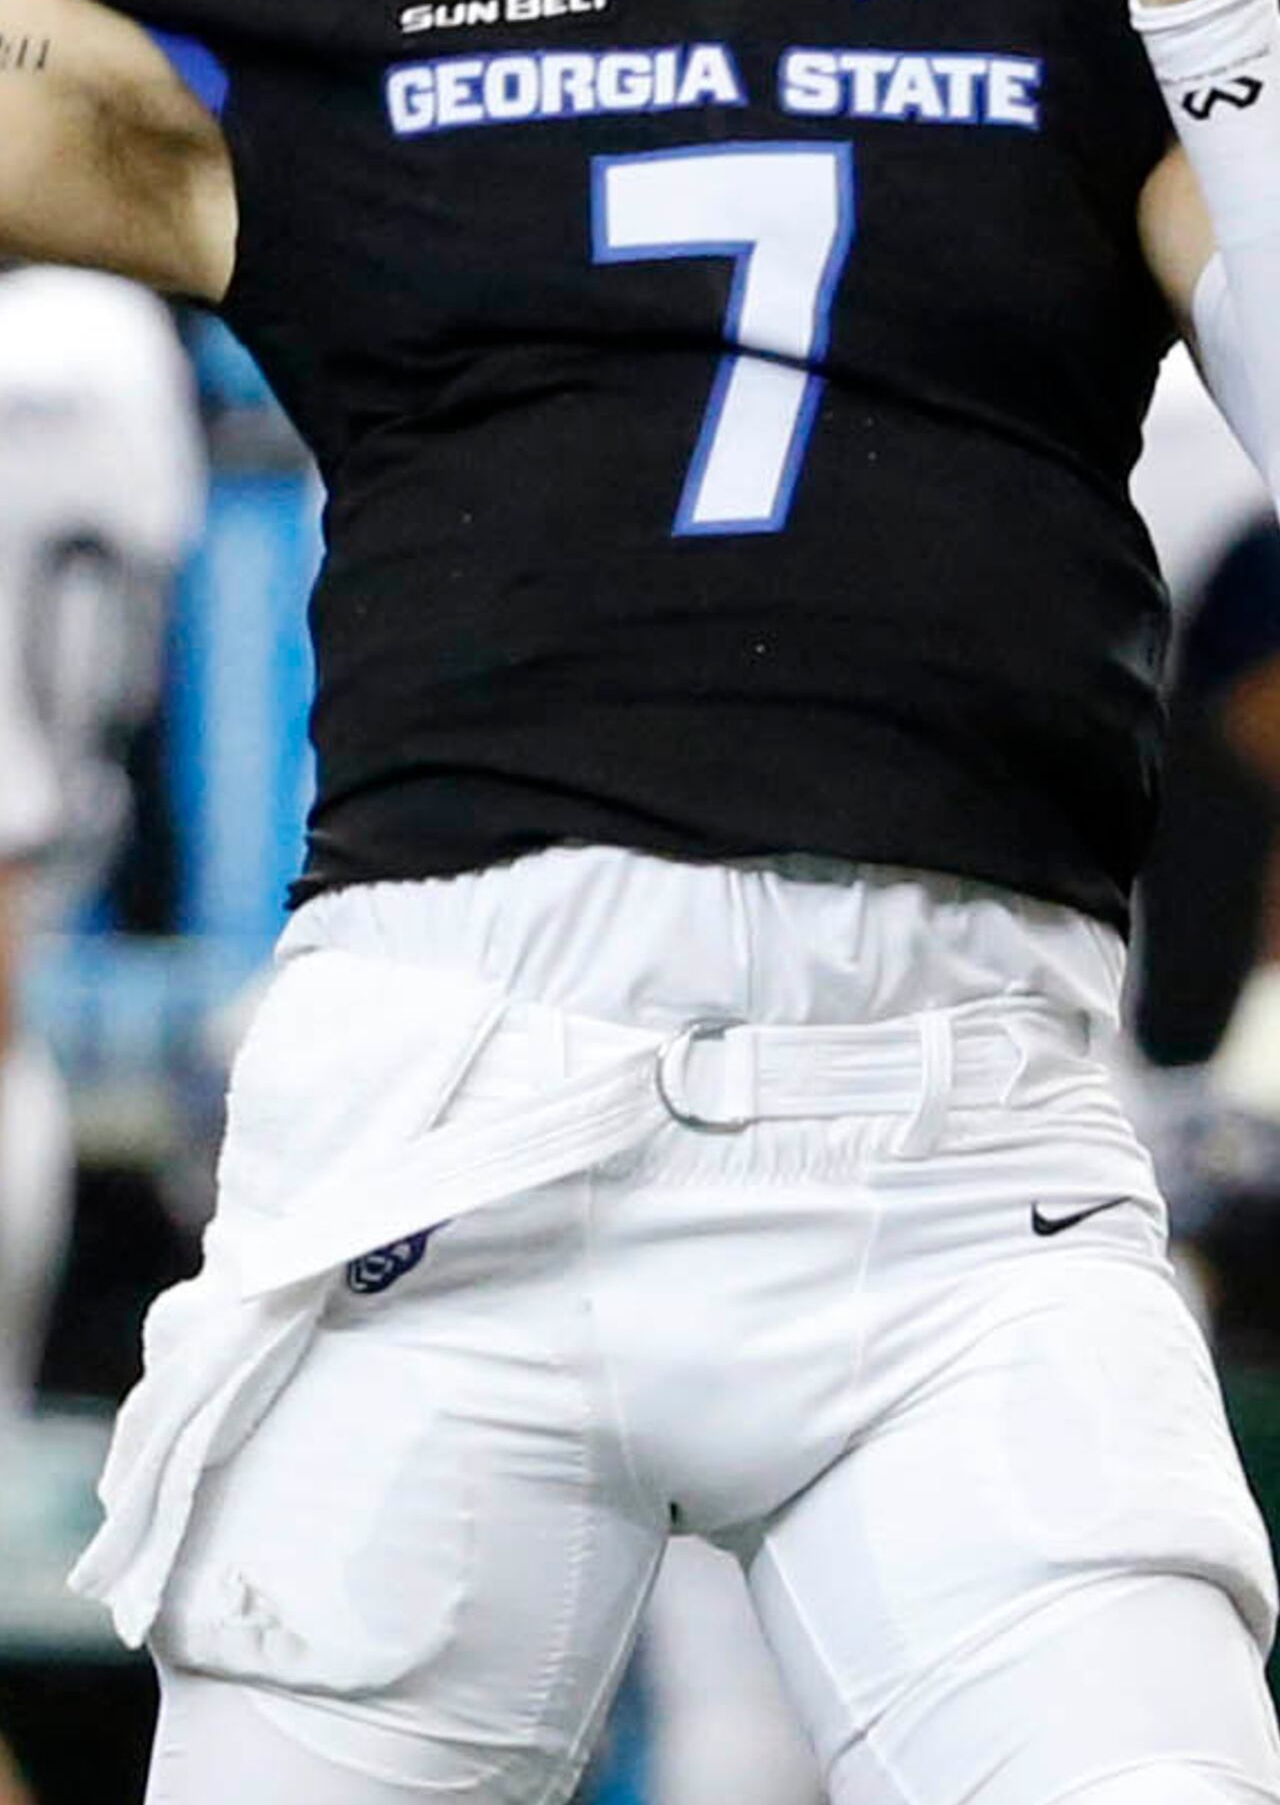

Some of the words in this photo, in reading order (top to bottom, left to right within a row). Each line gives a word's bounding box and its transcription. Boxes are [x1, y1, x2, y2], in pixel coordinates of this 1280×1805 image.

[387, 43, 746, 136] GEORGIA
[779, 45, 1043, 131] STATE
[590, 141, 854, 537] 7
